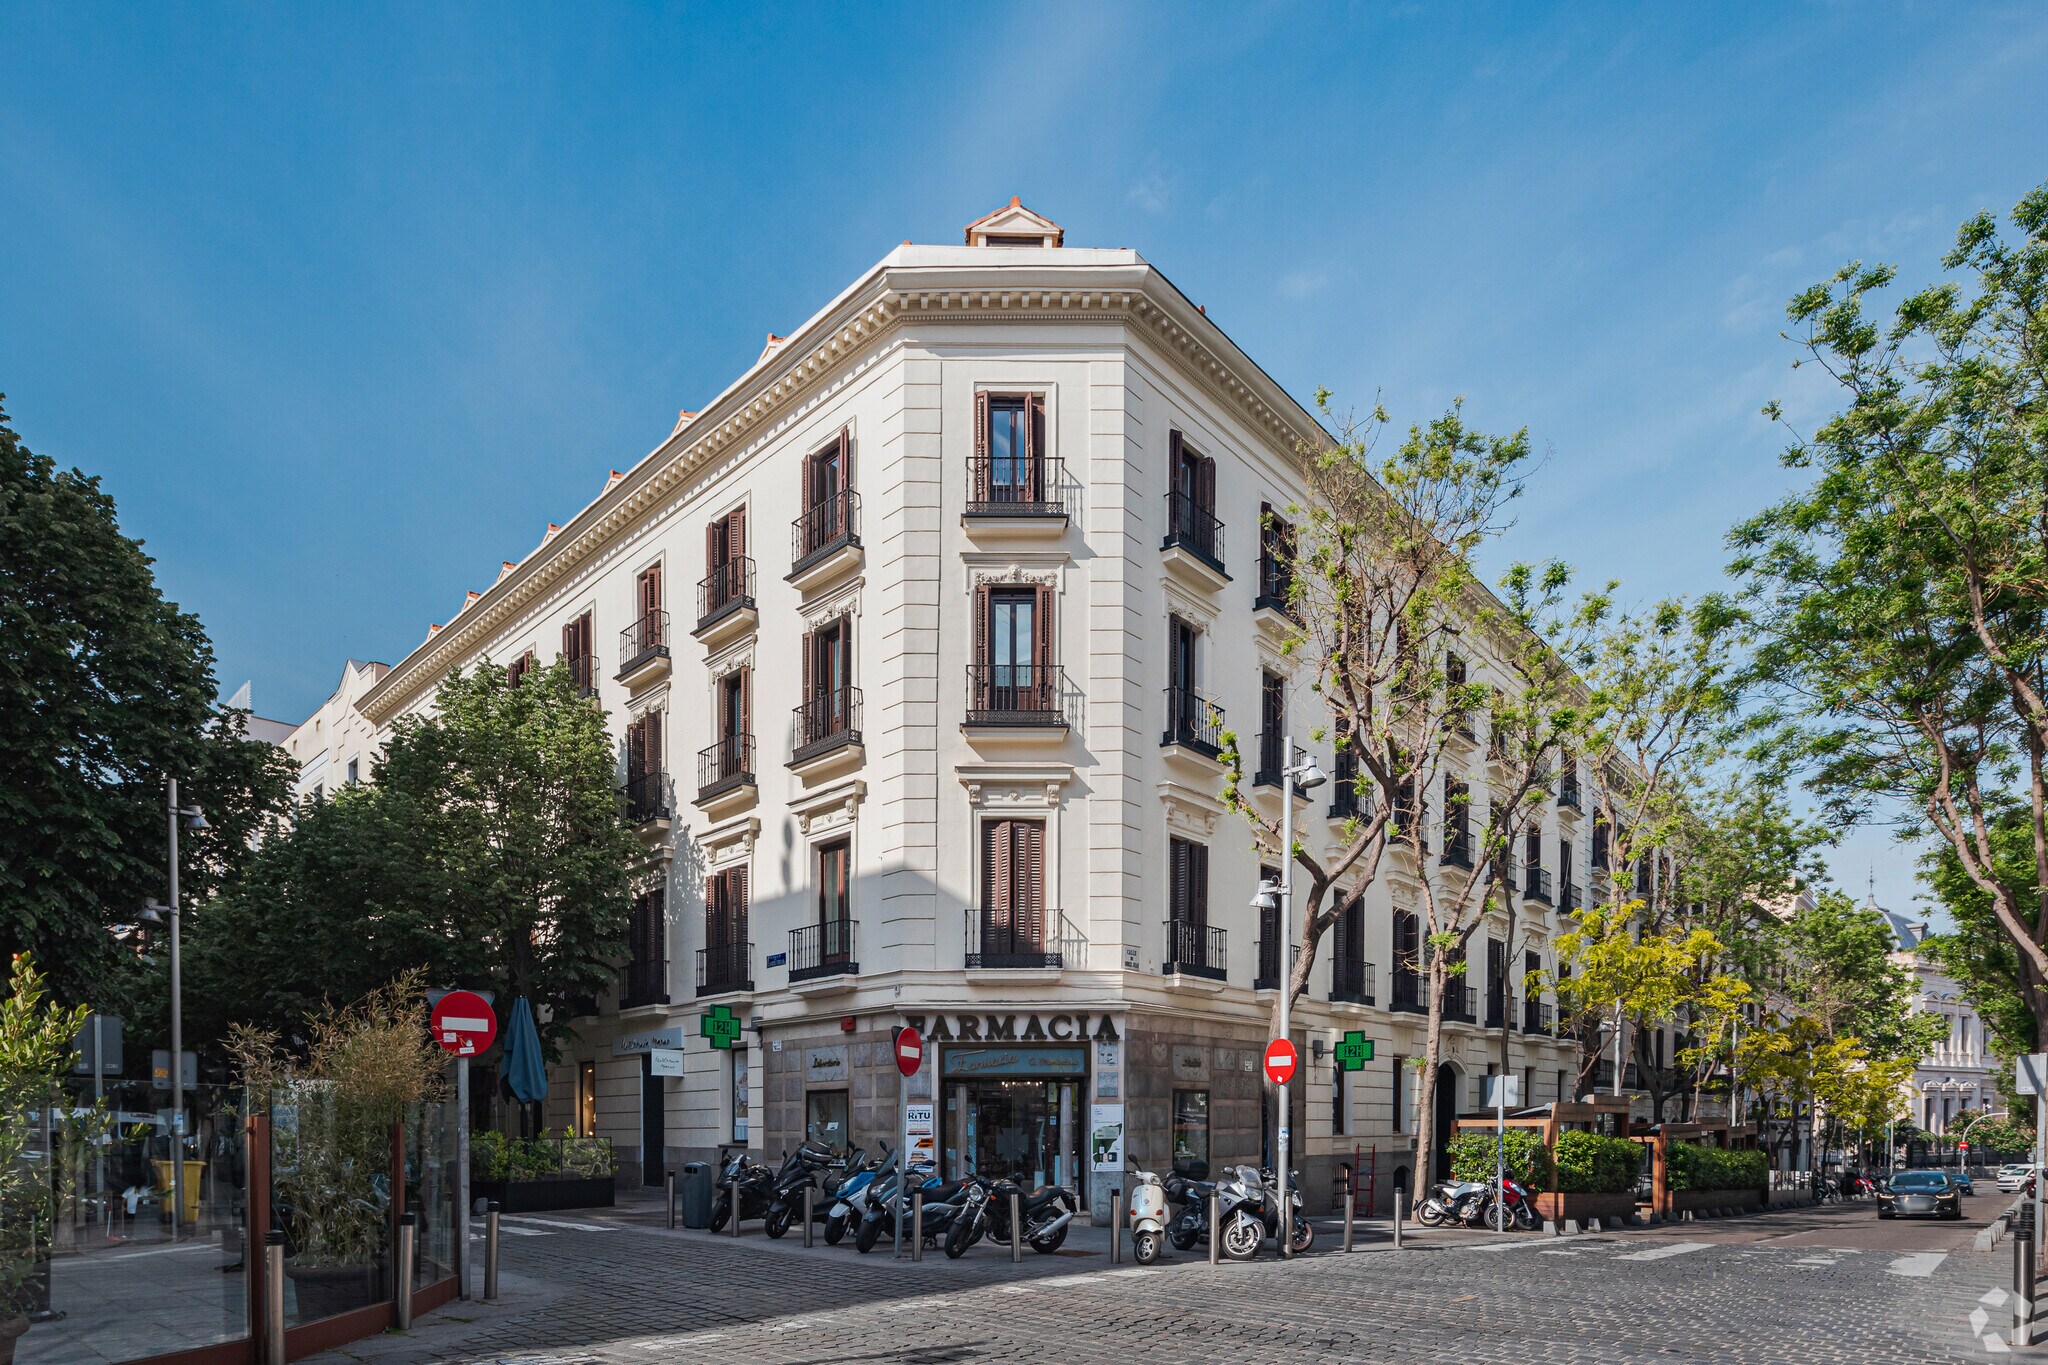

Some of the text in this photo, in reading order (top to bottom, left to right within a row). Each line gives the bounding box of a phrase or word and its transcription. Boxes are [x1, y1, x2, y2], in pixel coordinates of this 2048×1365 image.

[713, 1021, 731, 1034] 12H
[906, 1015, 1120, 1041] FARMACIA
[1344, 1045, 1363, 1057] 12H
